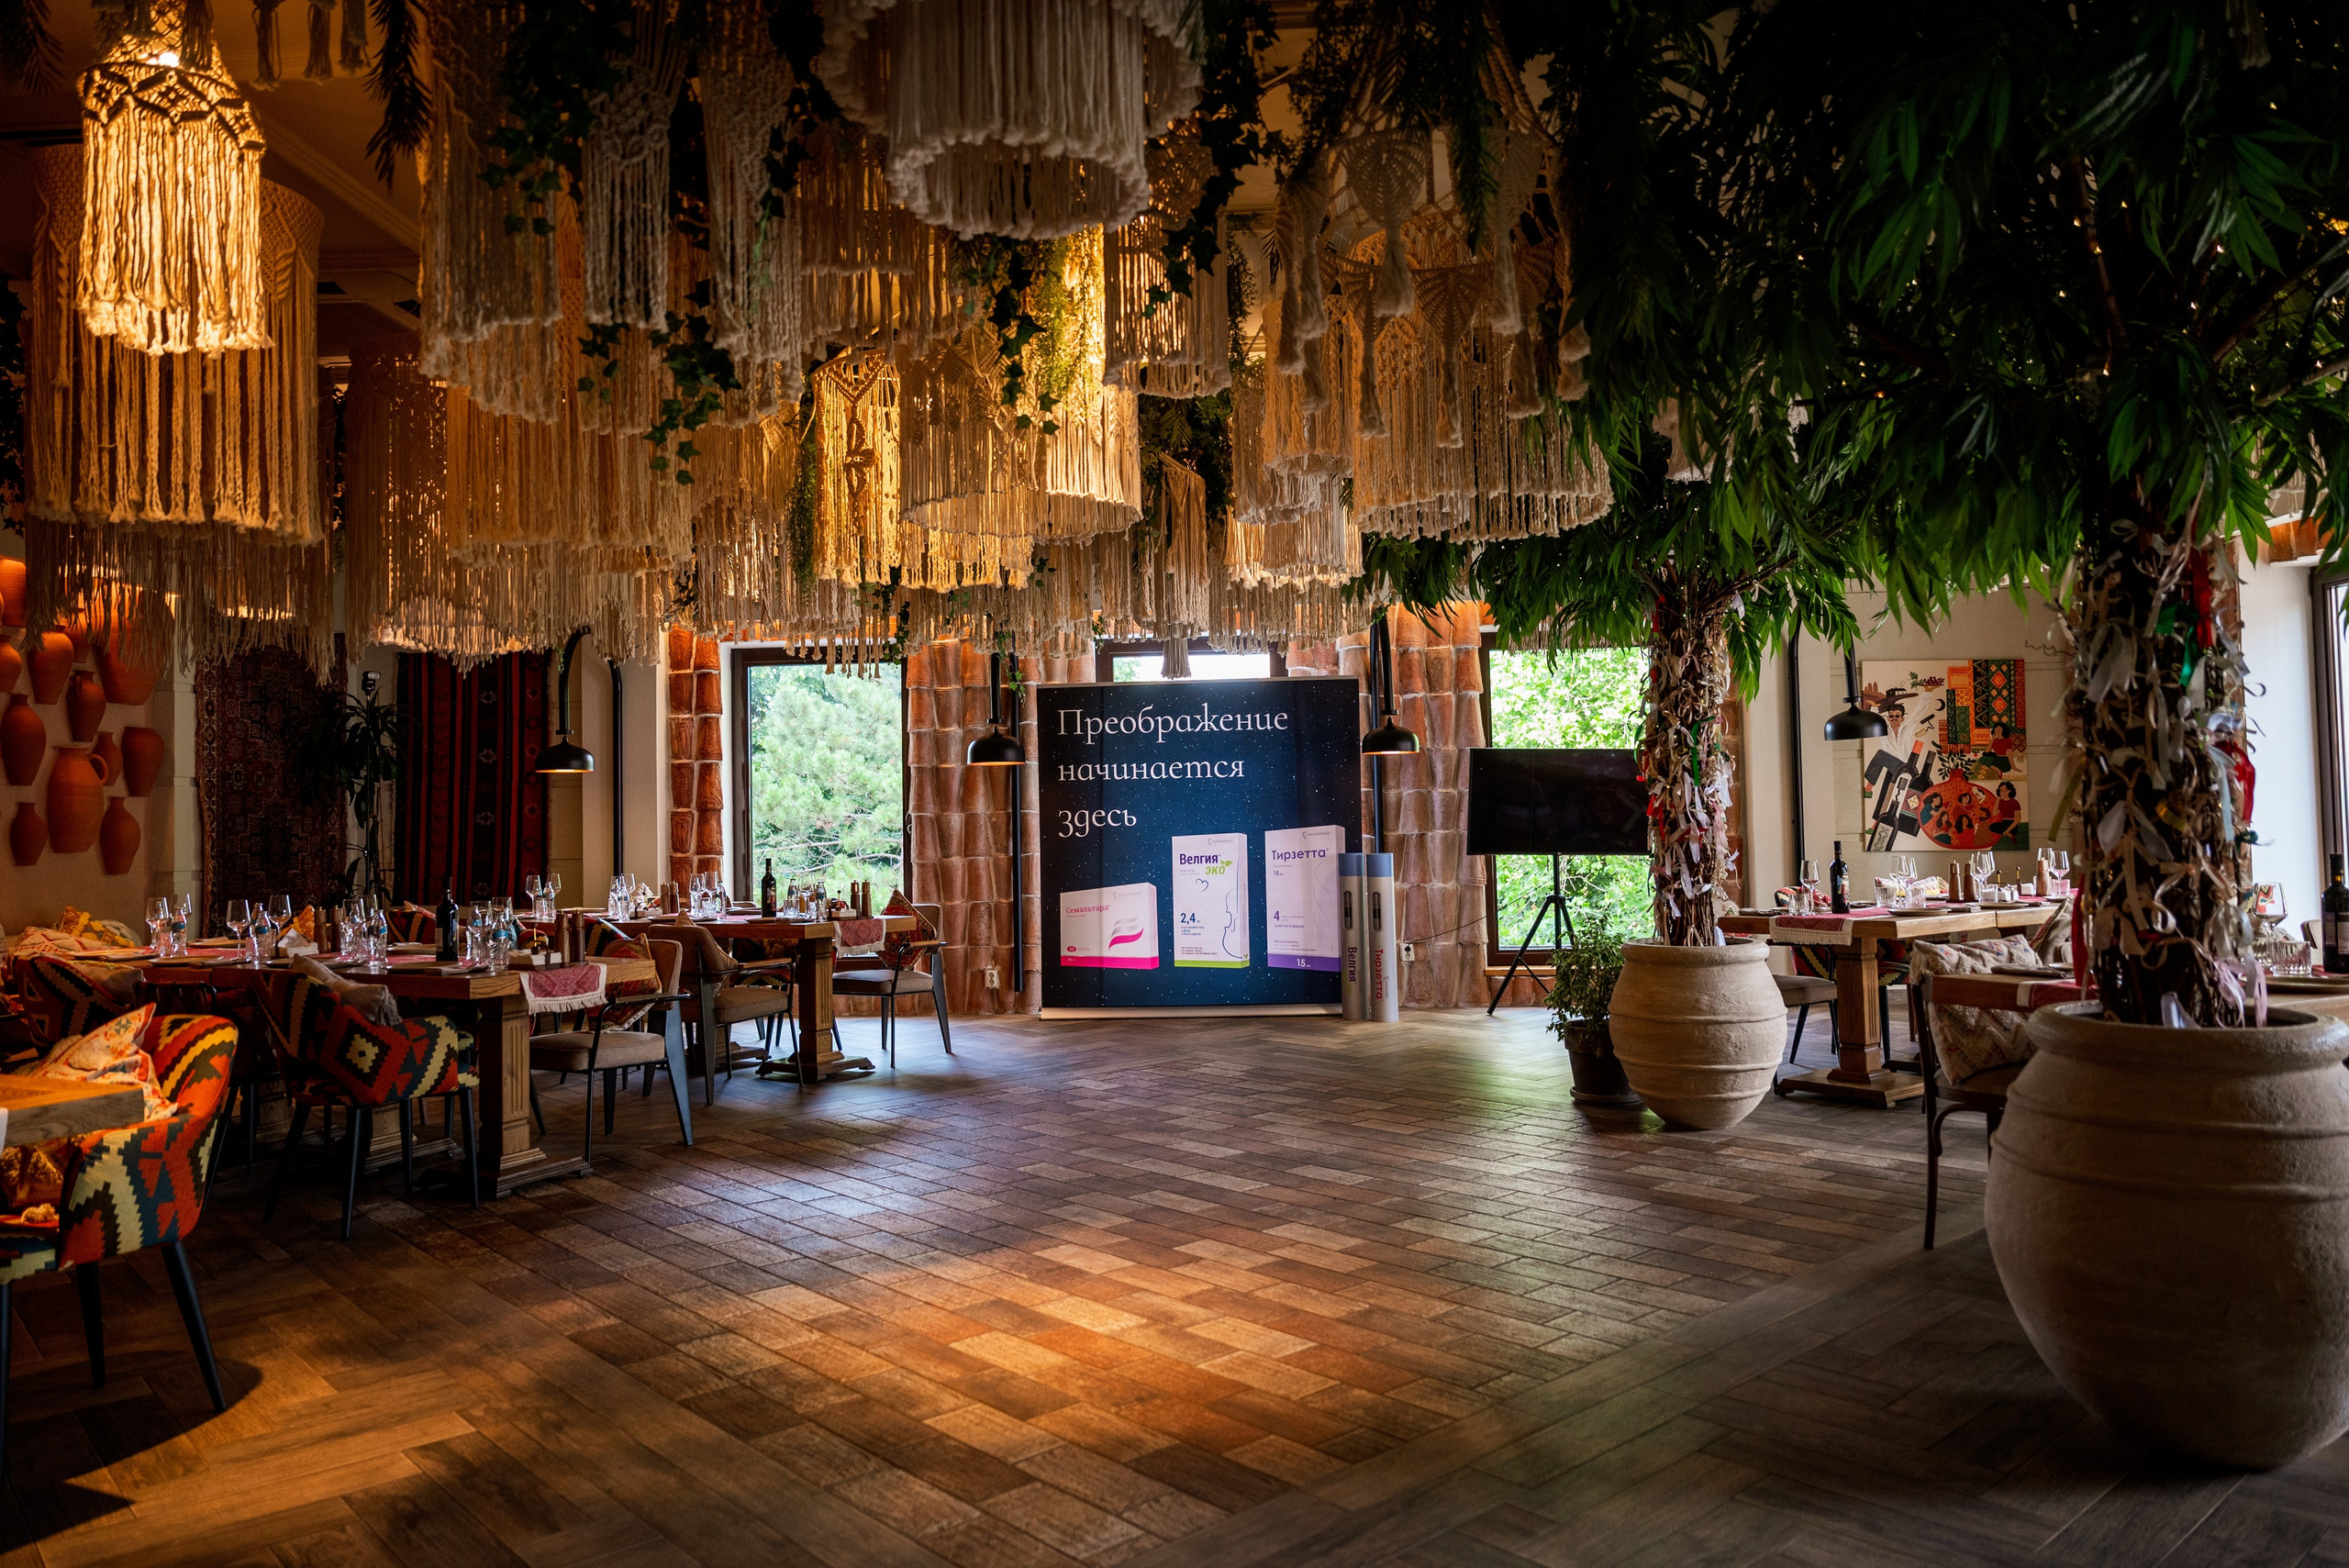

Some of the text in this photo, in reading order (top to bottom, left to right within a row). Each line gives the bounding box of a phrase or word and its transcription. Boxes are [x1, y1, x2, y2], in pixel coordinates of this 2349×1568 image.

[1057, 702, 1288, 745] Преображение
[1057, 760, 1245, 781] начинается
[1058, 809, 1137, 838] здесь
[1179, 853, 1219, 865] Велгия
[1271, 849, 1326, 862] Тирзетта
[1065, 905, 1109, 915] Семальтара
[1273, 910, 1280, 921] 4
[1180, 912, 1196, 925] 2,4
[1297, 958, 1306, 968] 15
[1347, 947, 1358, 983] Велгия
[1374, 949, 1384, 999] Тирзетта
